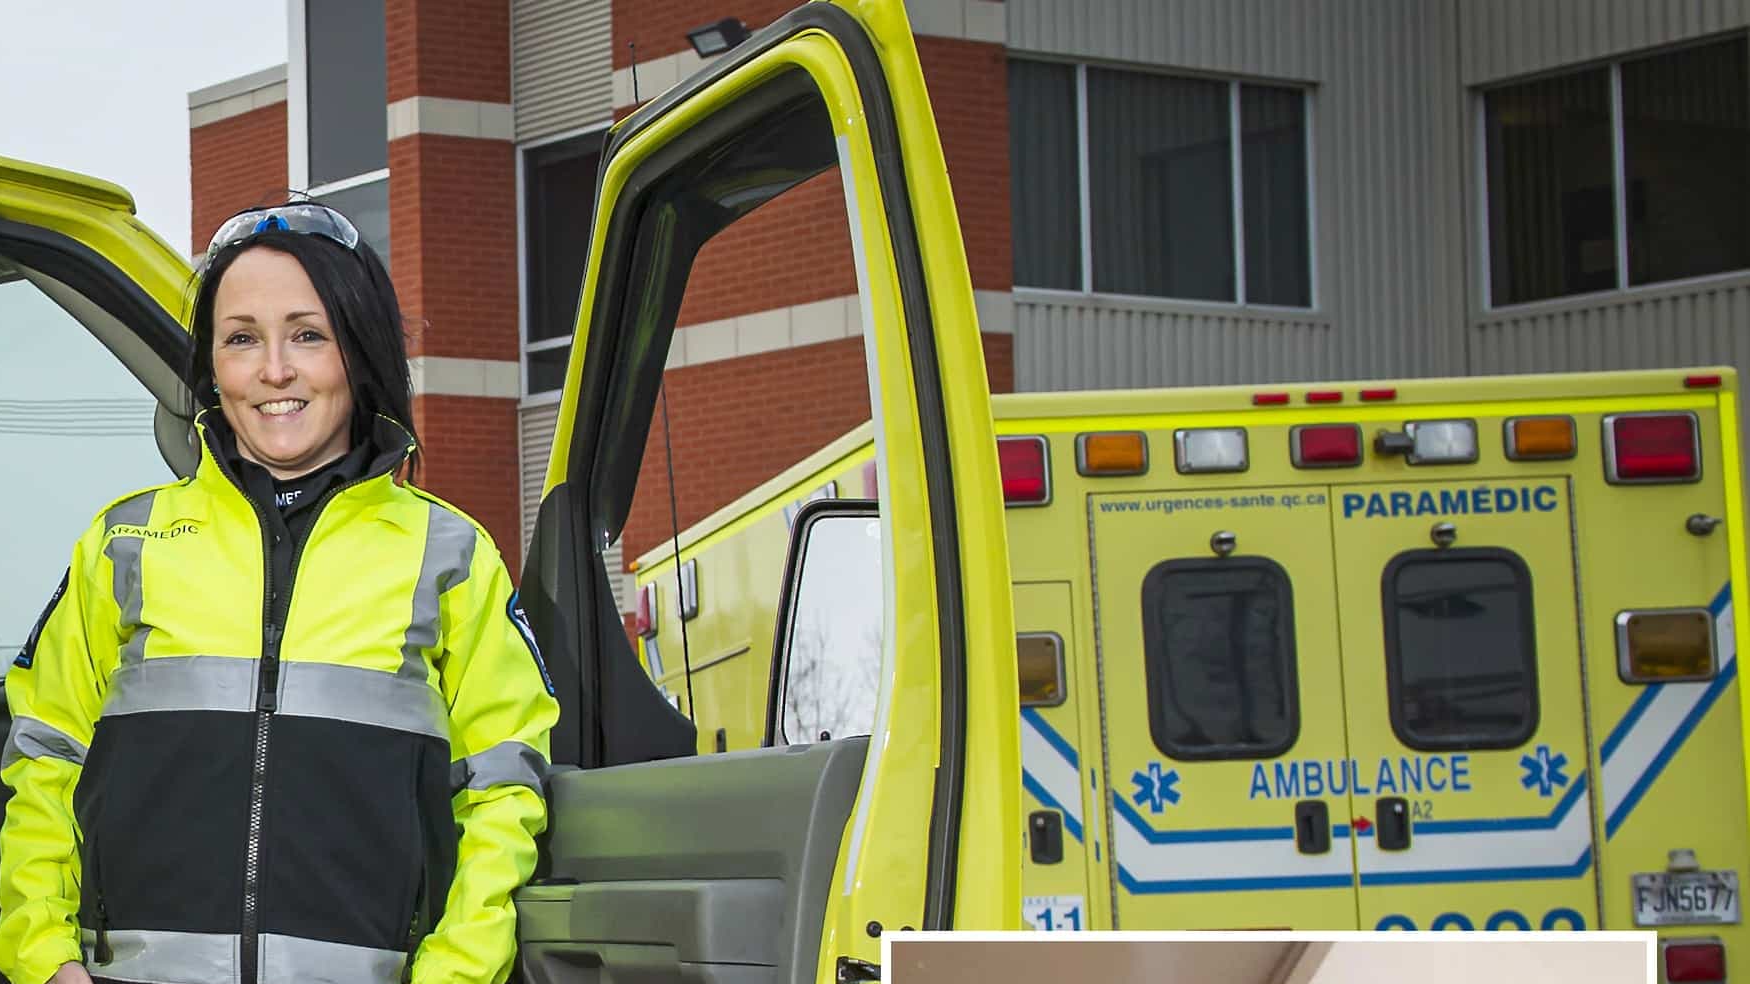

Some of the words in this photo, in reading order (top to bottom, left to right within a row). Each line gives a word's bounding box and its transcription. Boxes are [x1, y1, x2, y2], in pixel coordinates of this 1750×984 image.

[1099, 492, 1326, 515] www.urgences-sante.qc.ca
[1342, 485, 1558, 519] PARAMÉDIC
[1250, 755, 1472, 799] AMBULANCE
[1411, 800, 1434, 819] A2
